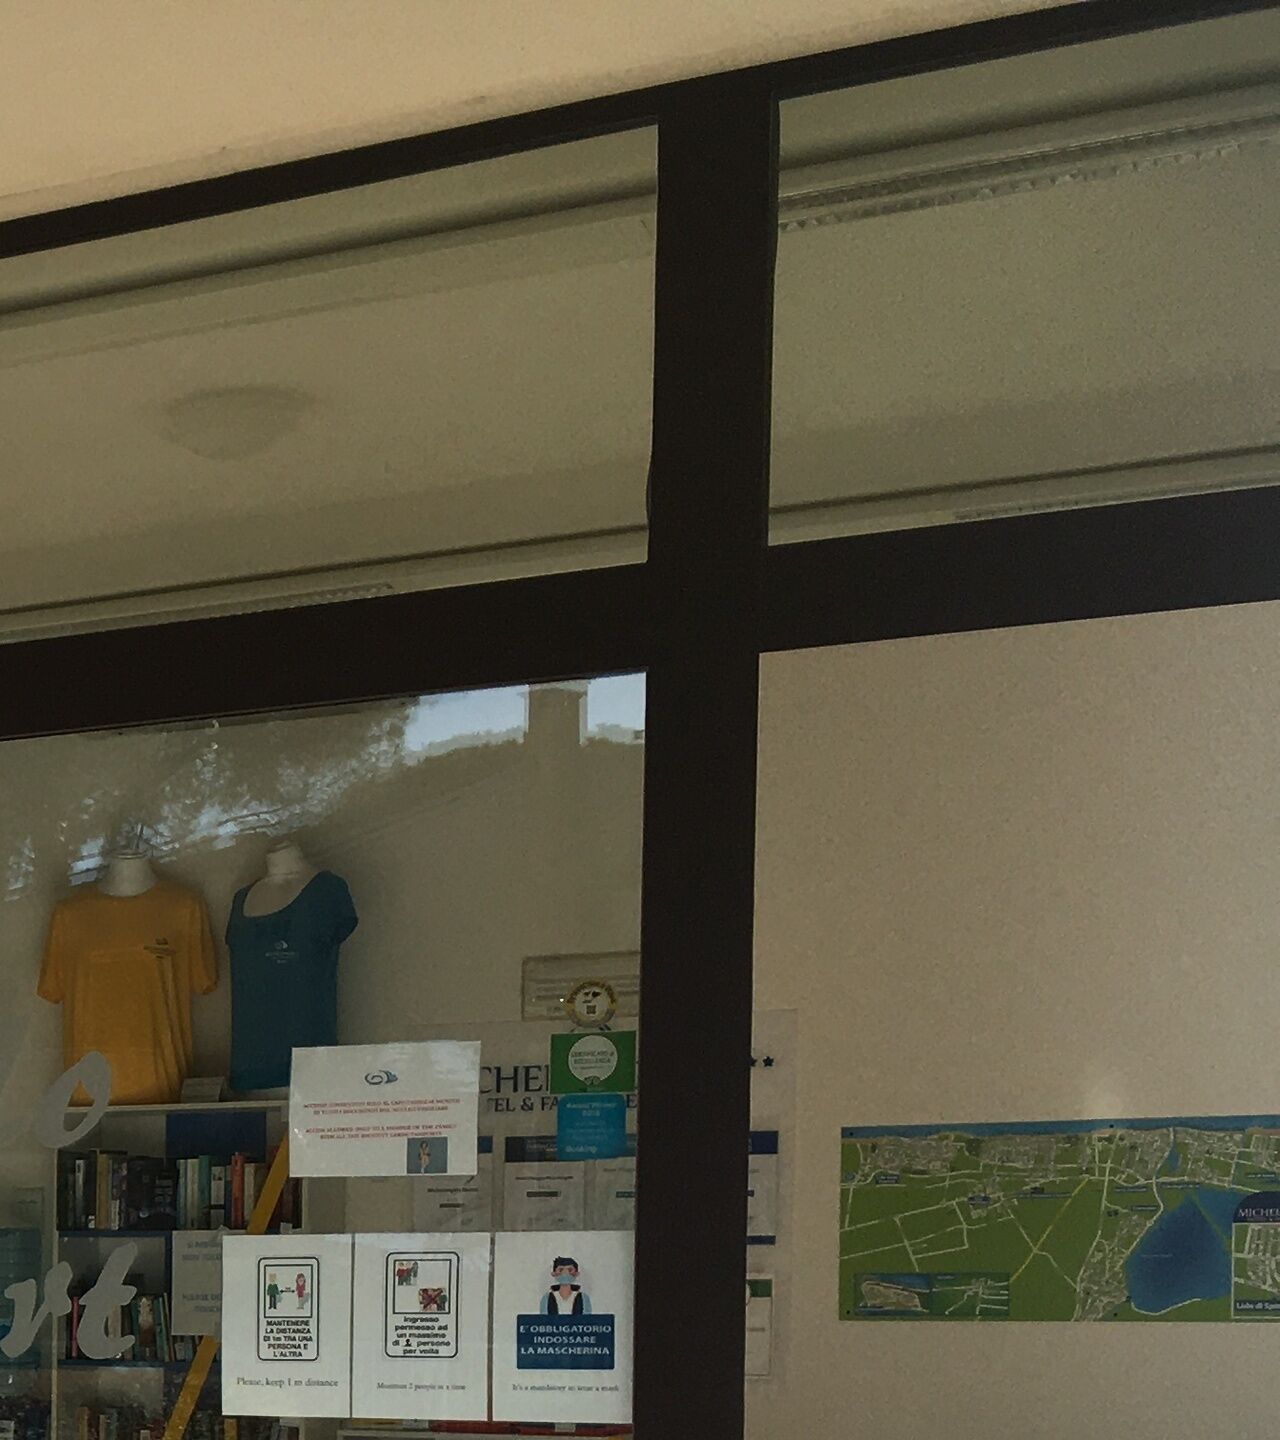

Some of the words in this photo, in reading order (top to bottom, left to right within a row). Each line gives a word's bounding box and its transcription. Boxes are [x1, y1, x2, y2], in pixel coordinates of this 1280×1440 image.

[266, 1319, 310, 1327] MANTENERE
[403, 1315, 439, 1323] Ingresso
[394, 1324, 436, 1332] permesso
[530, 1325, 612, 1333] OBBLIGATORIO
[416, 1340, 451, 1348] persone
[534, 1336, 597, 1344] INDOSSARE
[403, 1348, 417, 1356] per
[419, 1347, 439, 1355] volta
[521, 1346, 534, 1355] LA
[537, 1346, 610, 1355] MASCHERINA
[265, 1377, 284, 1388] keep
[305, 1378, 338, 1387] distance
